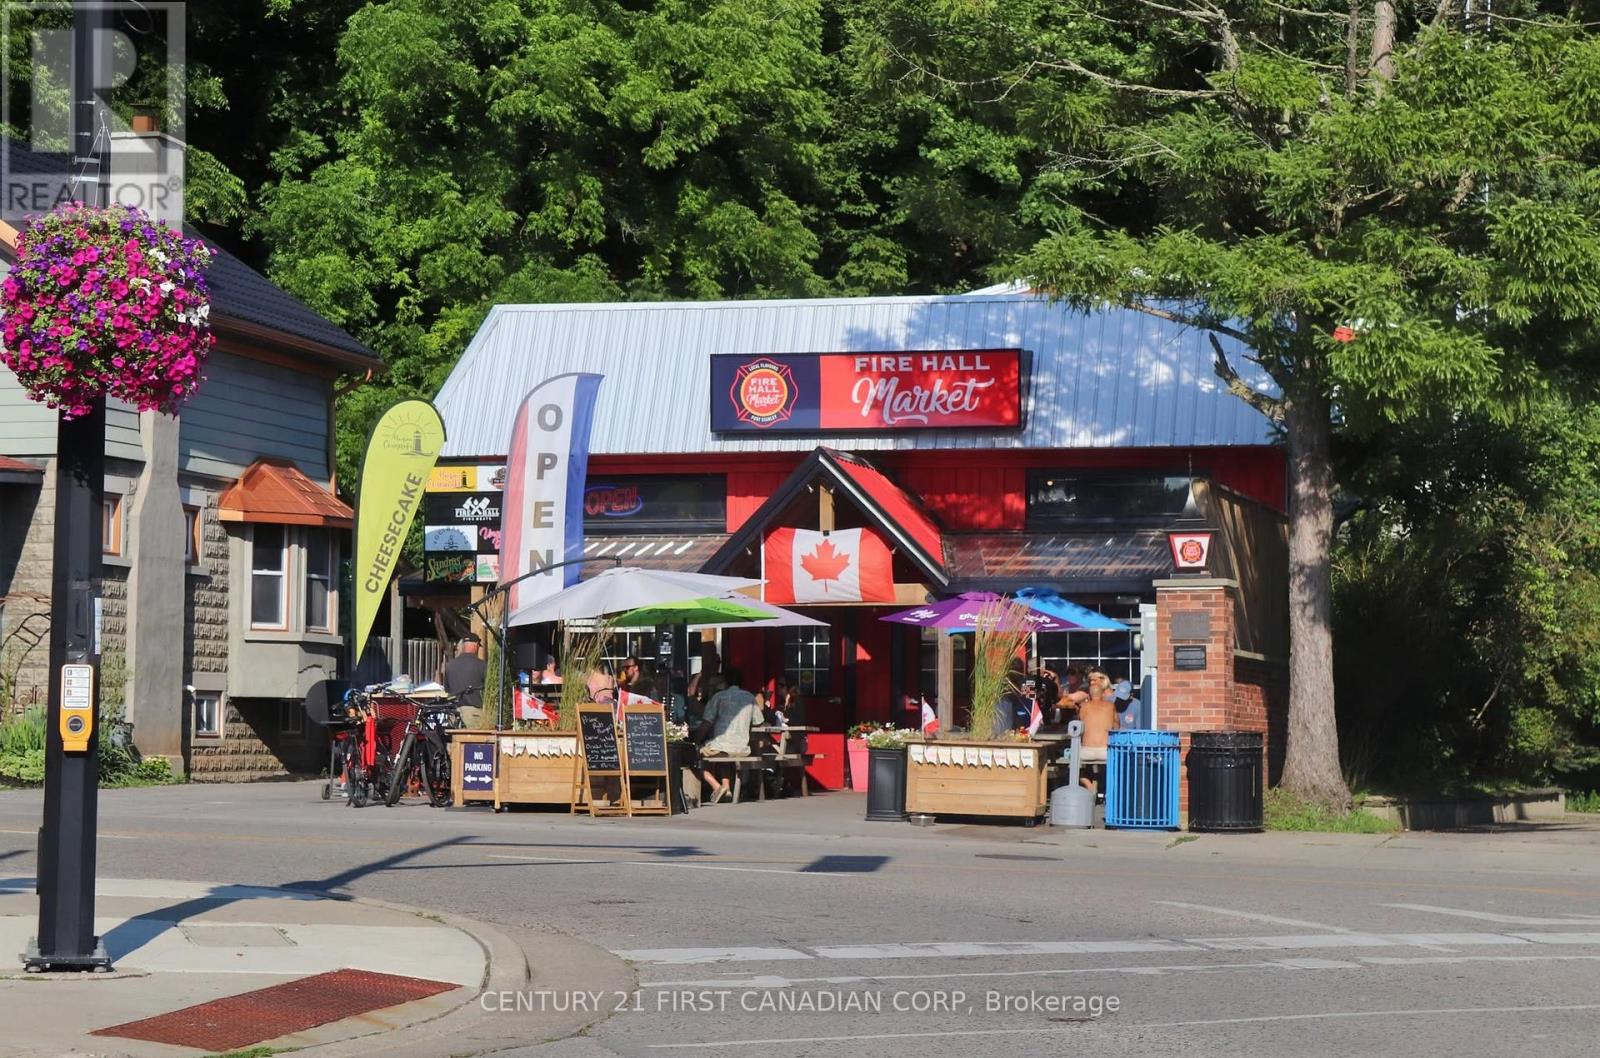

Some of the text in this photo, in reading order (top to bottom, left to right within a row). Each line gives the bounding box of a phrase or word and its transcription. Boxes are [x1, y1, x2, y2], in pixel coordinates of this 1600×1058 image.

[855, 354, 991, 373] FIRE HALL
[748, 385, 780, 393] HALL
[750, 377, 778, 386] FIRE
[746, 393, 785, 408] Market
[851, 376, 996, 425] Market
[585, 485, 638, 516] OPEN
[364, 472, 422, 594] CHEESECAKE
[473, 751, 484, 761] NO
[464, 762, 492, 772] PARKING
